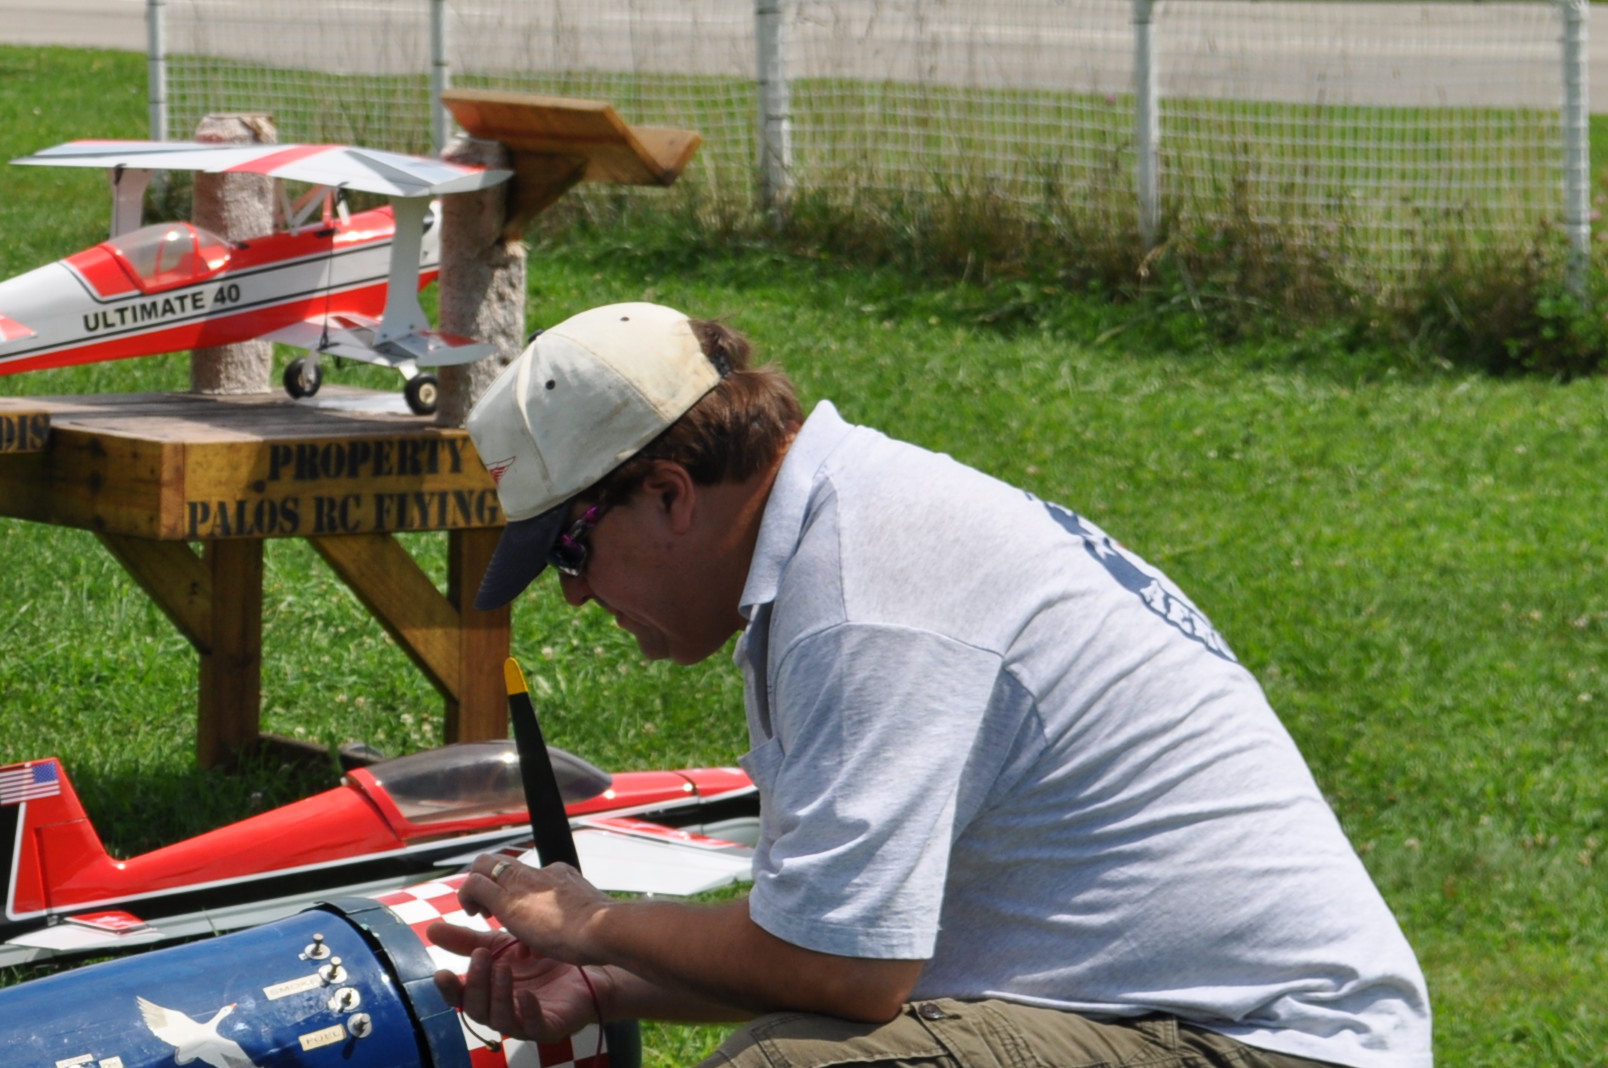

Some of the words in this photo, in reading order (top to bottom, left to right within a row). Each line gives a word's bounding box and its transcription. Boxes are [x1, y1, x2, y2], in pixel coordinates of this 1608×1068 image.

[82, 290, 206, 332] ULTIMATE
[213, 284, 241, 305] 40
[267, 437, 472, 481] PROPERTY
[185, 498, 301, 538] PALOS
[312, 493, 362, 534] RC
[373, 488, 499, 531] FLYING
